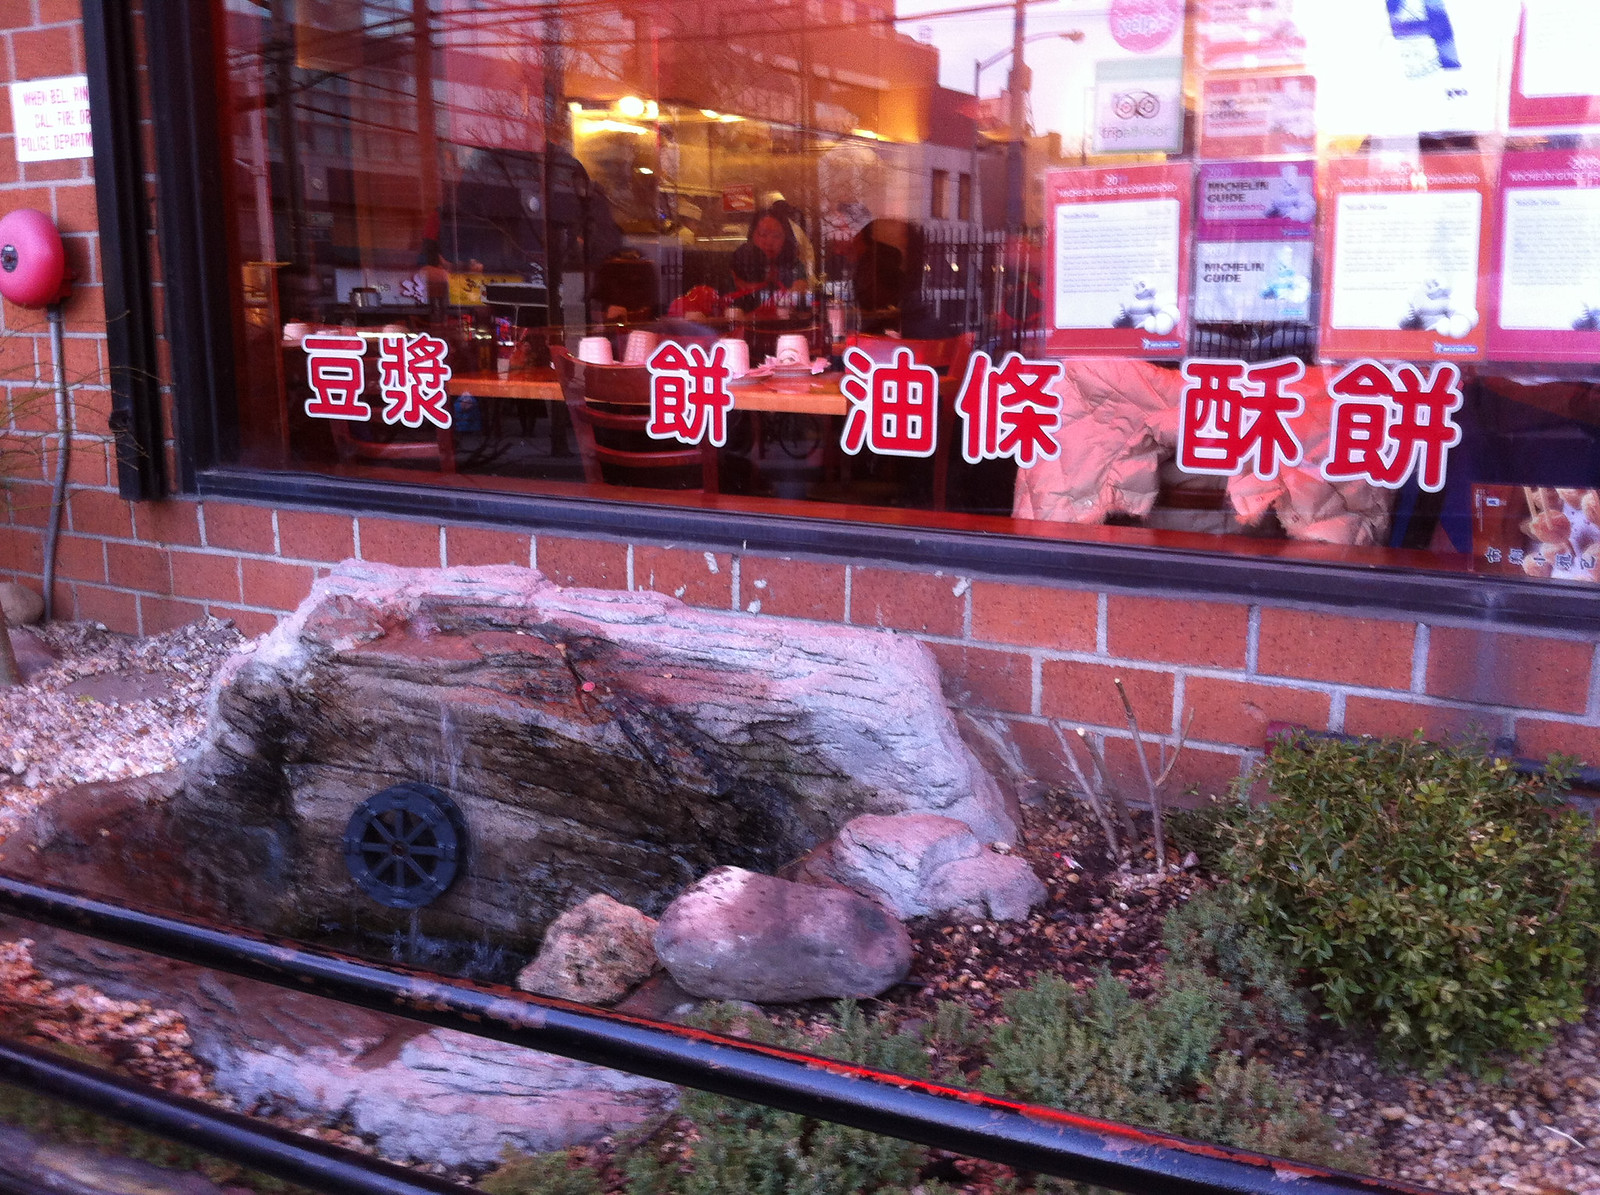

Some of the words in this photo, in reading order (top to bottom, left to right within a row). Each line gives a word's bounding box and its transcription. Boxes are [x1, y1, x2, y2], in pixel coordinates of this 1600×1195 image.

[1118, 14, 1157, 38] yelp
[23, 90, 48, 106] WHEN
[57, 110, 76, 126] FIRE
[21, 135, 51, 152] POLICE
[1207, 181, 1269, 192] MICHELIN
[1207, 193, 1246, 203] GUIDE
[1203, 262, 1265, 272] MICHELIN
[1203, 273, 1242, 283] GUIDE
[302, 332, 453, 430] 豆漿
[645, 339, 736, 448] 餅
[839, 346, 1066, 470] 油條
[1176, 356, 1465, 494] 酥餅
